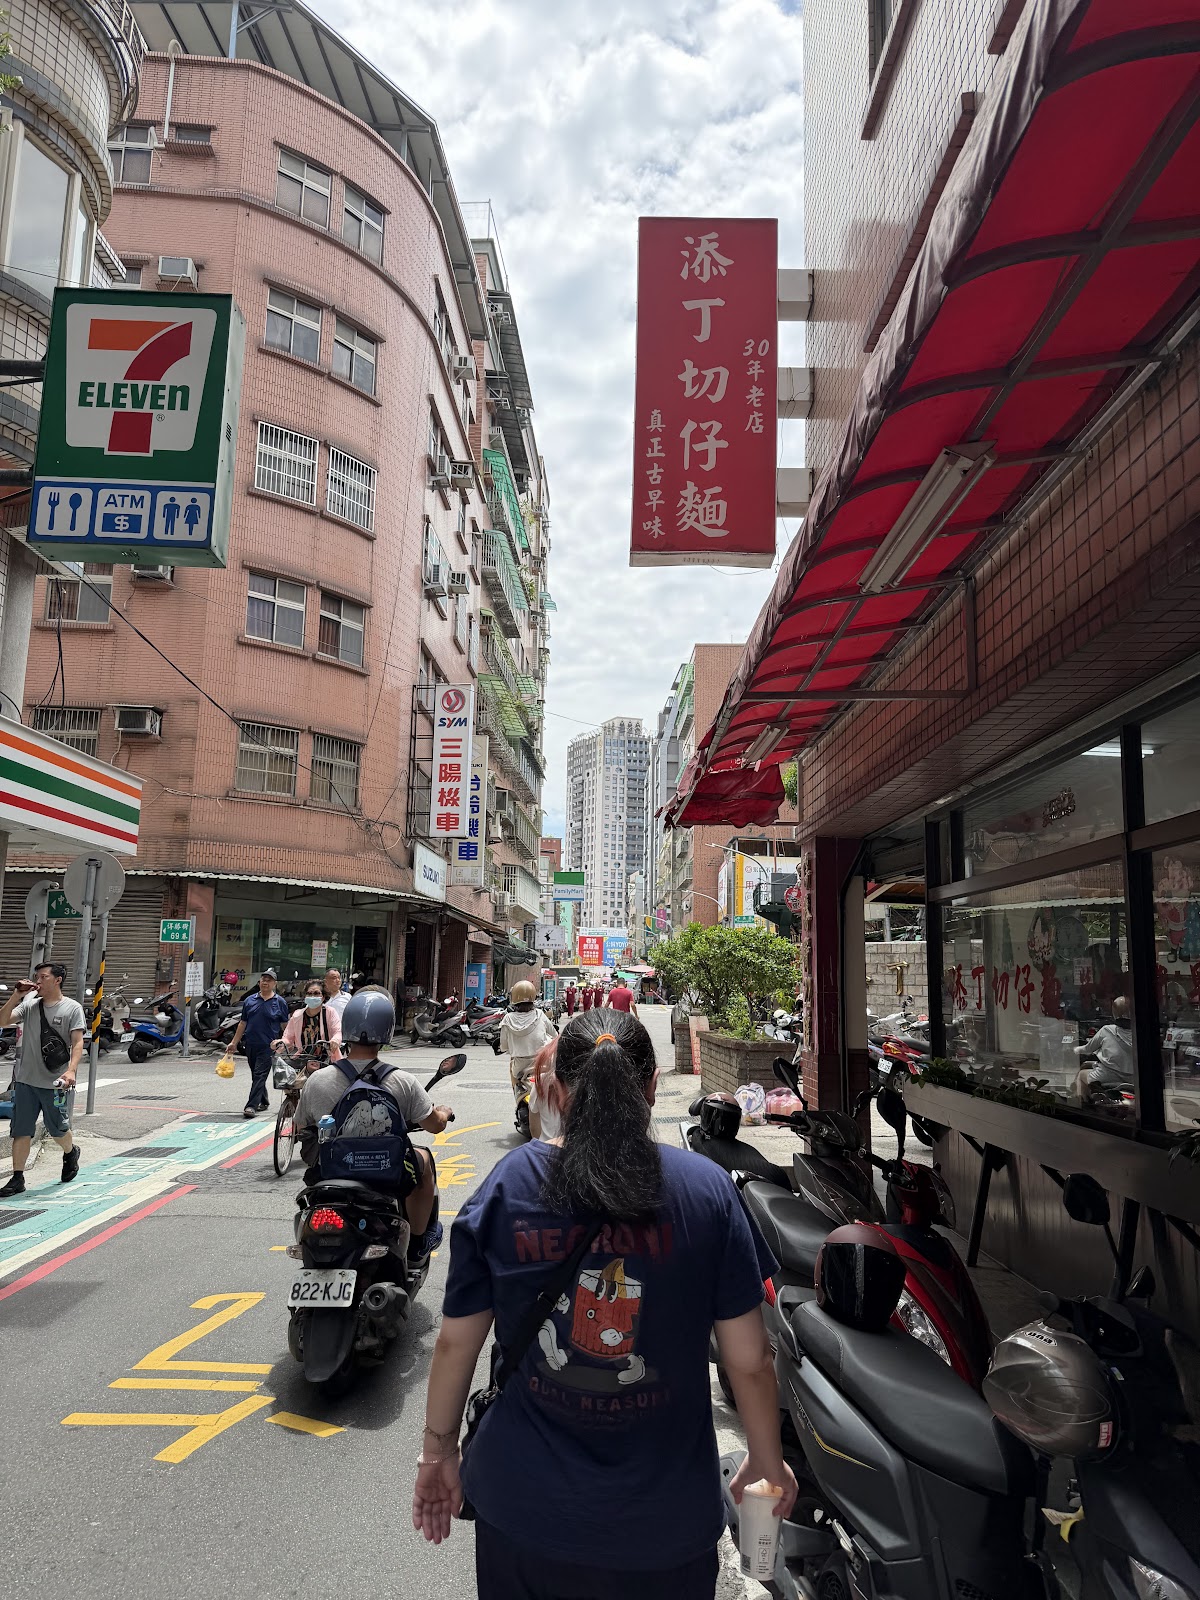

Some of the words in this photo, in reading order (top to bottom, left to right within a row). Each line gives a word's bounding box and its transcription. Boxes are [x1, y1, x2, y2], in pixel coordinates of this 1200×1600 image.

[88, 318, 193, 454] 7
[676, 231, 734, 538] 添丁切仔麵
[742, 338, 770, 434] 30年老店
[104, 493, 144, 509] ATM
[642, 408, 666, 540] 真正古早味
[438, 717, 467, 727] SYM
[436, 738, 463, 832] 三陽機車
